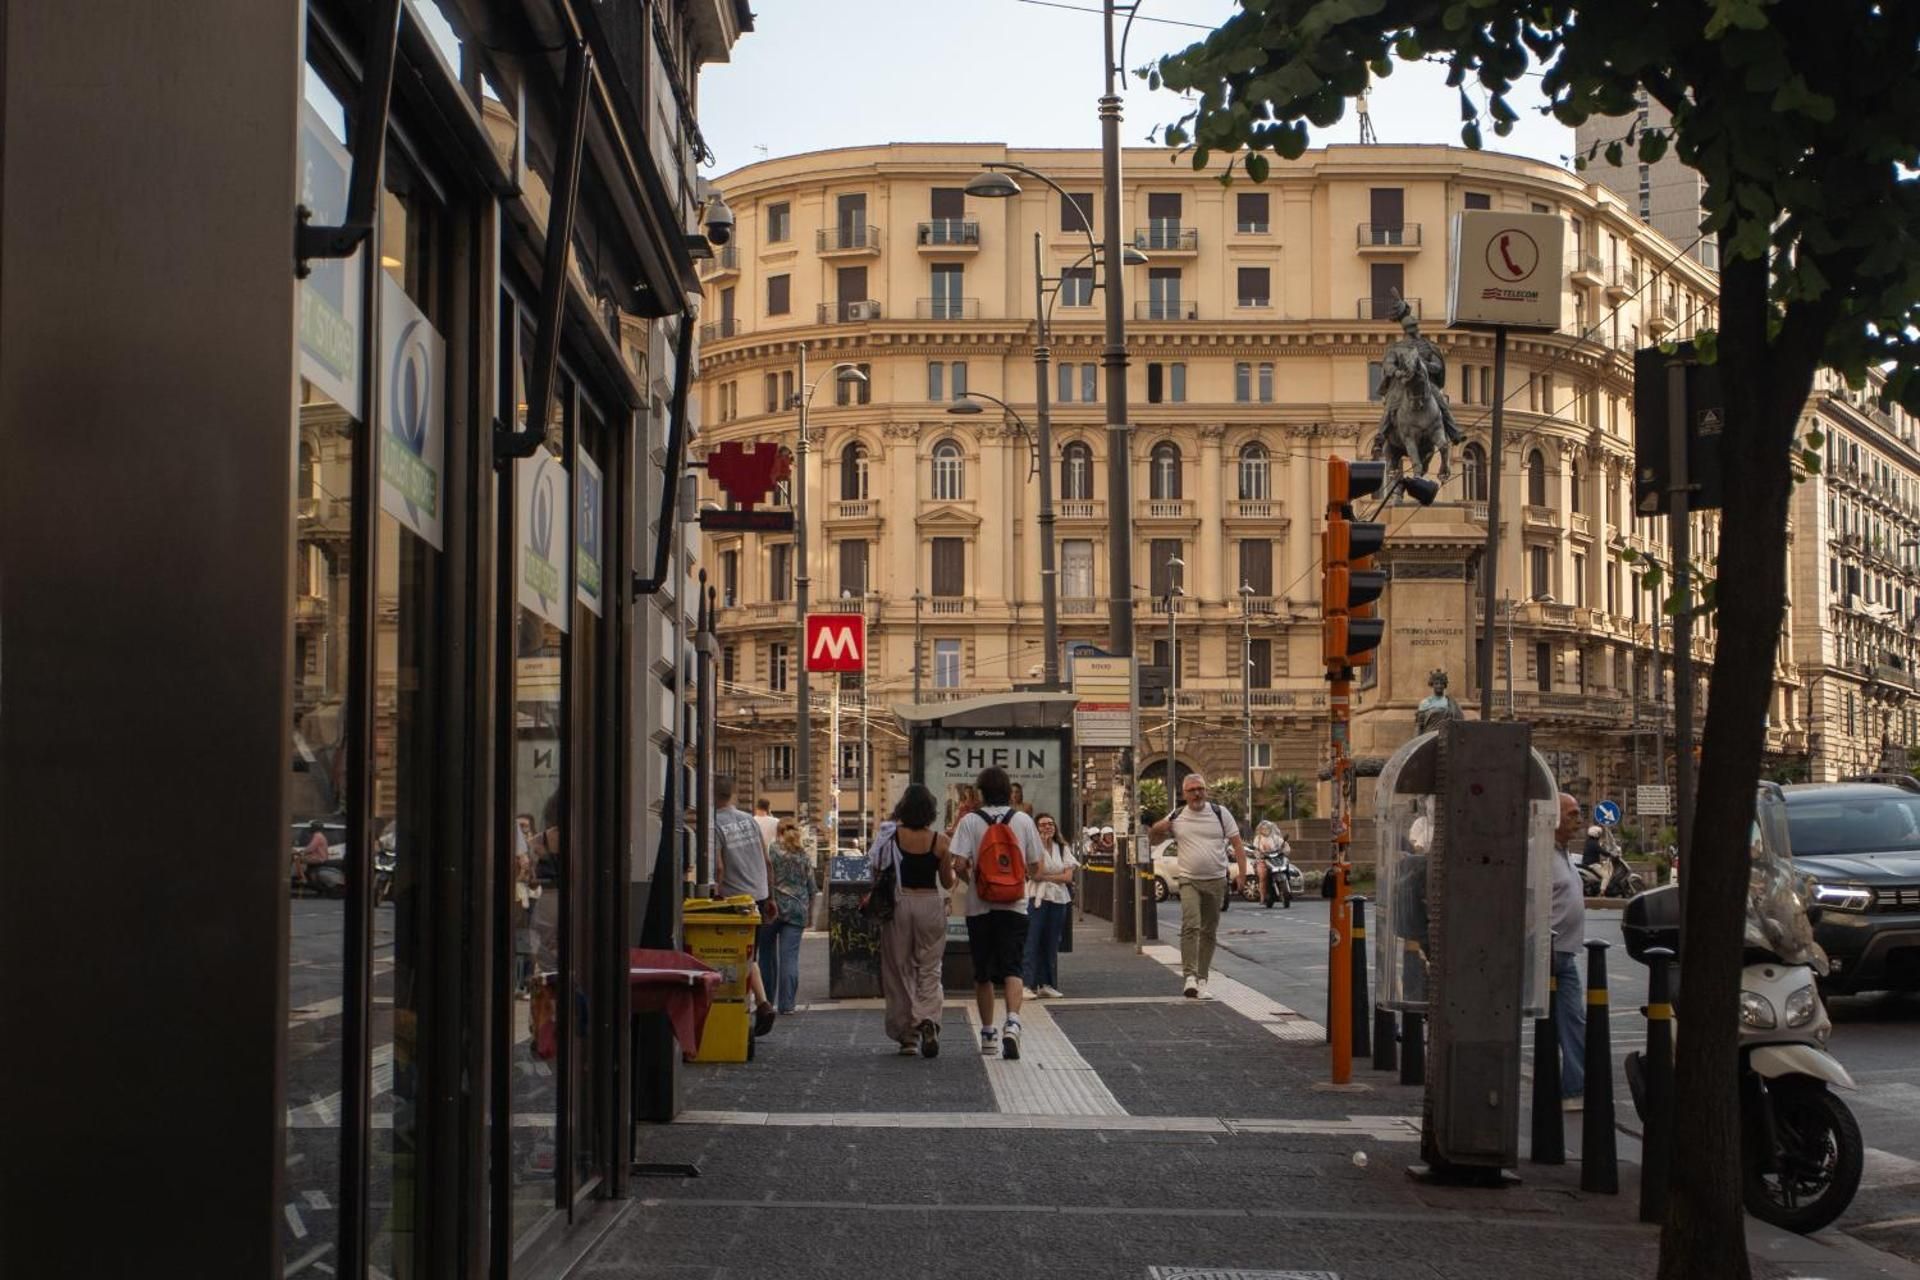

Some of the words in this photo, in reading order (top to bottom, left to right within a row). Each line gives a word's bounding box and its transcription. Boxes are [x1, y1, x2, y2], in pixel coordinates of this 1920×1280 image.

[1503, 289, 1539, 298] TELECOM
[811, 626, 860, 660] M
[945, 747, 1045, 769] SHEIN
